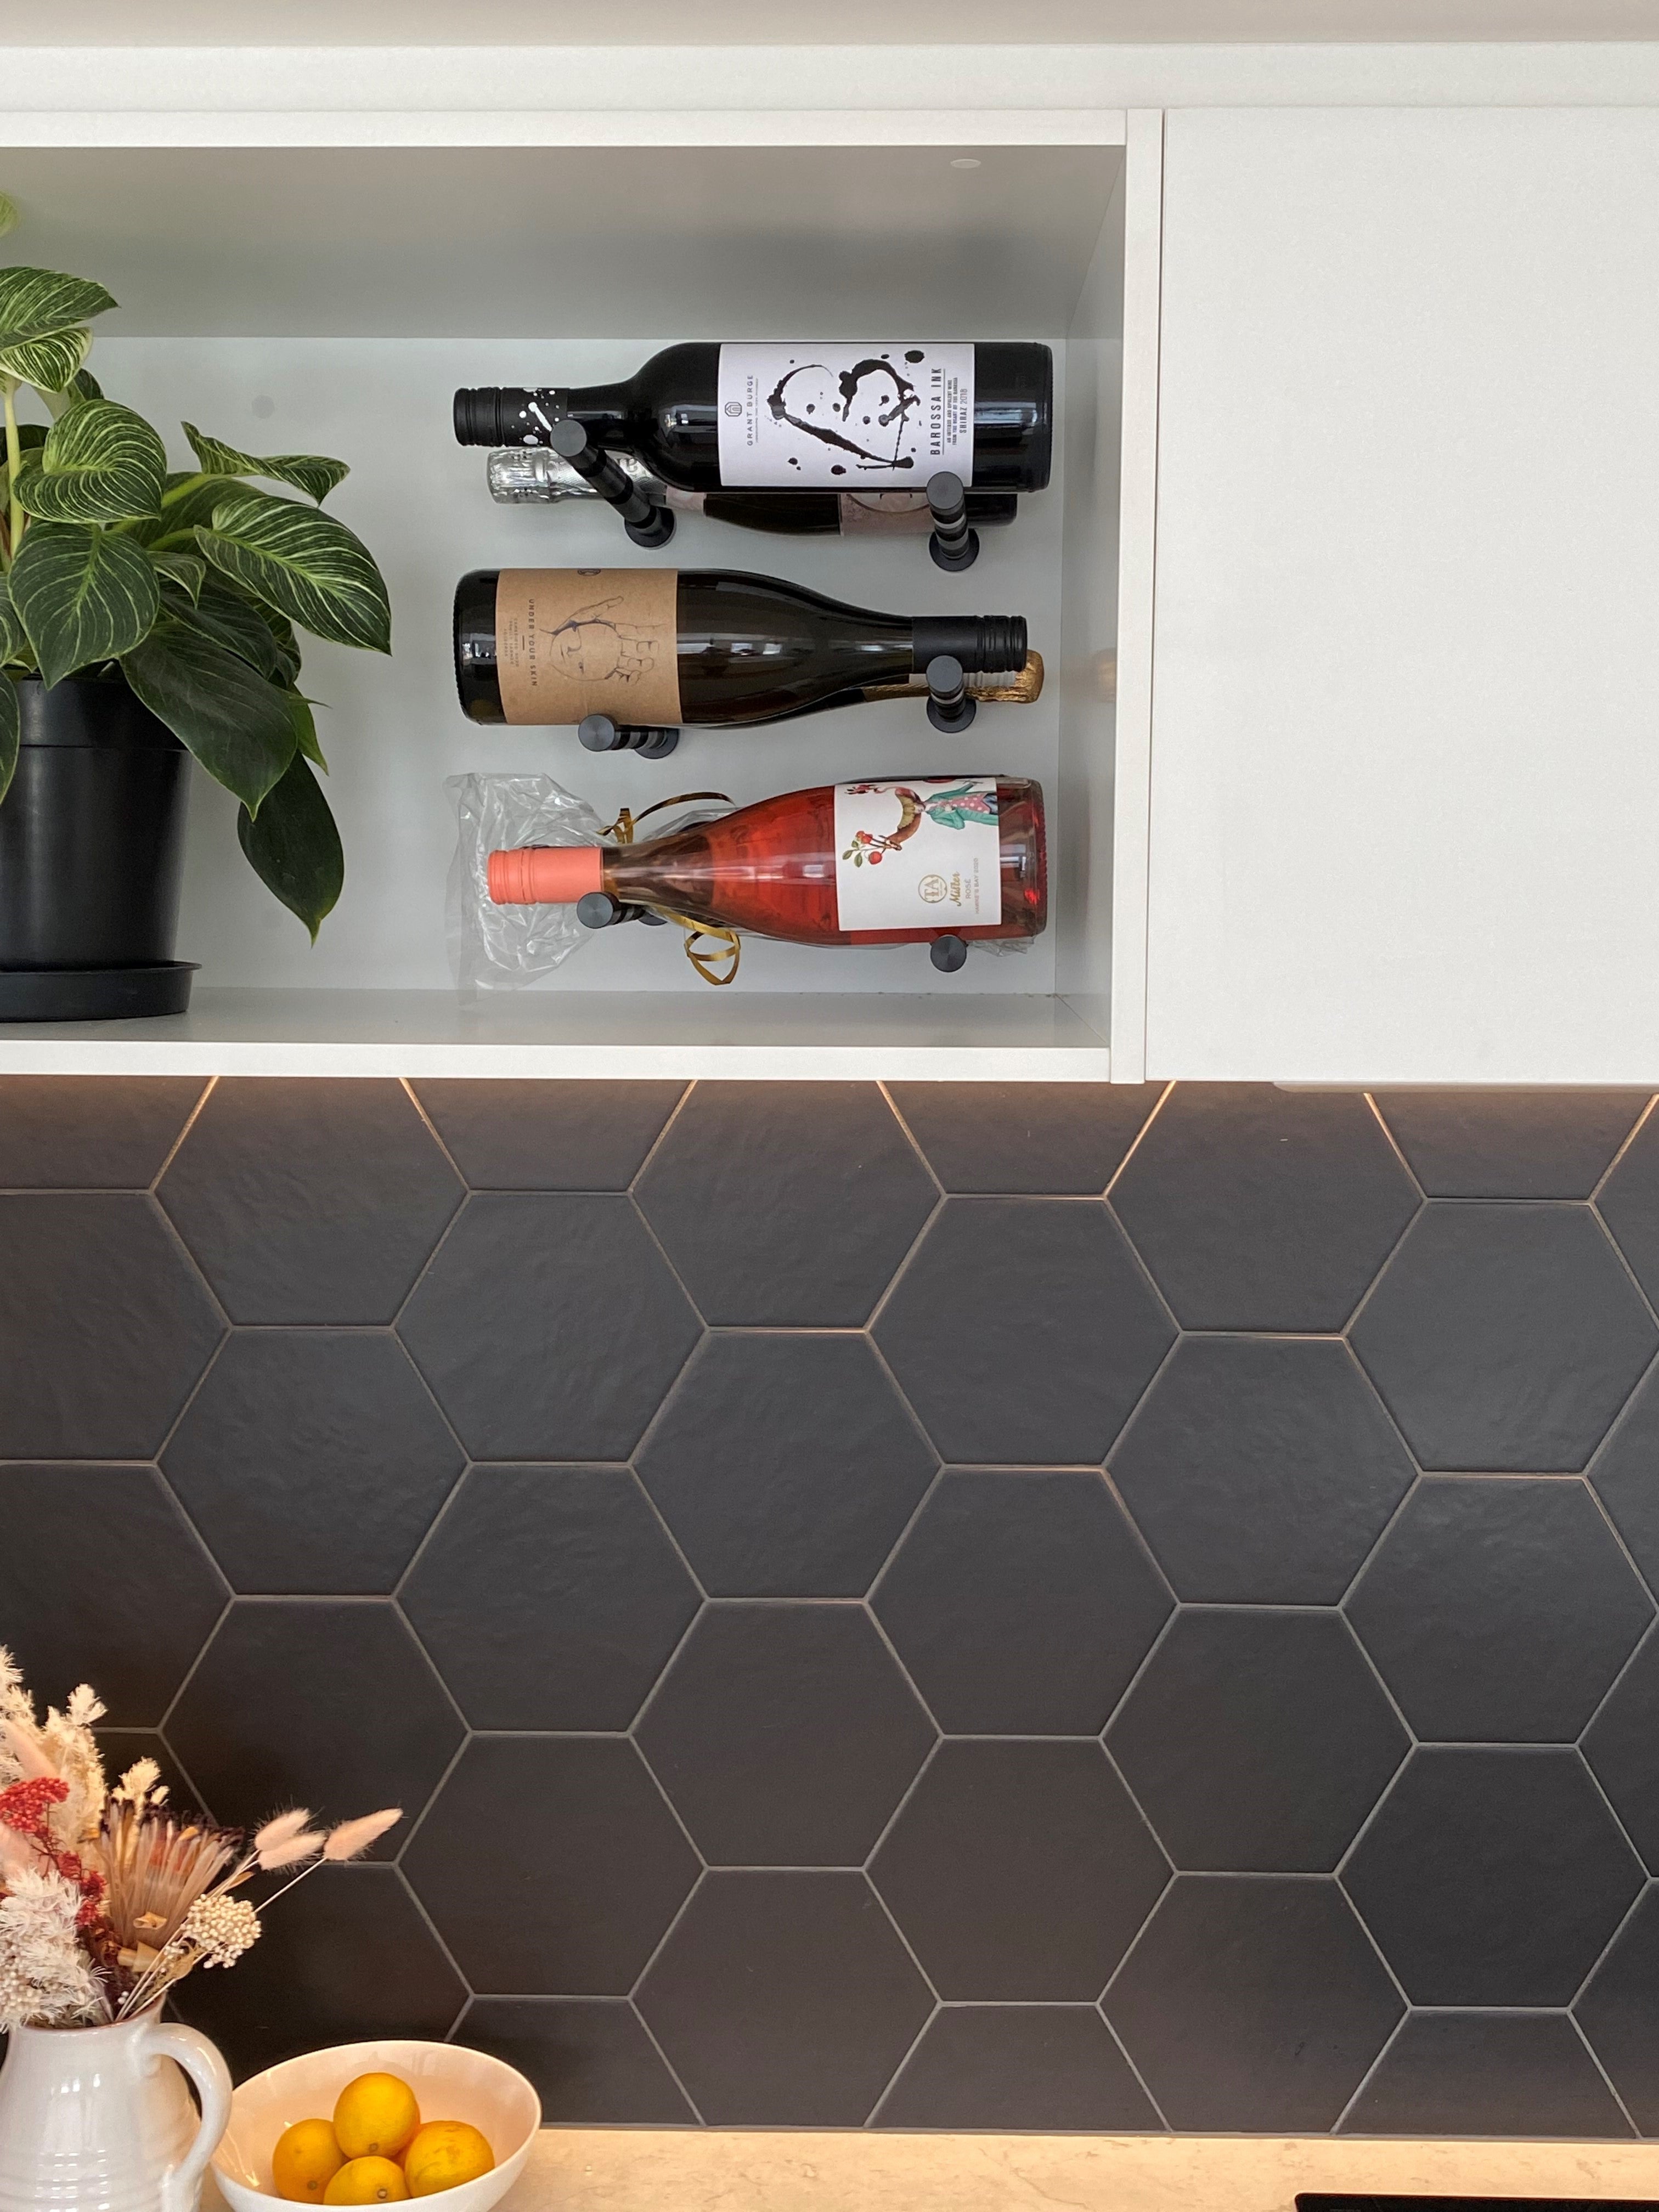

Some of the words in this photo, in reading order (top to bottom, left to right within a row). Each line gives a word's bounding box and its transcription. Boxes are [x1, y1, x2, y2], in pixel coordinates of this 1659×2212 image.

[931, 368, 941, 387] INK
[930, 396, 941, 455] BAROSSA
[949, 871, 962, 906] Mister
